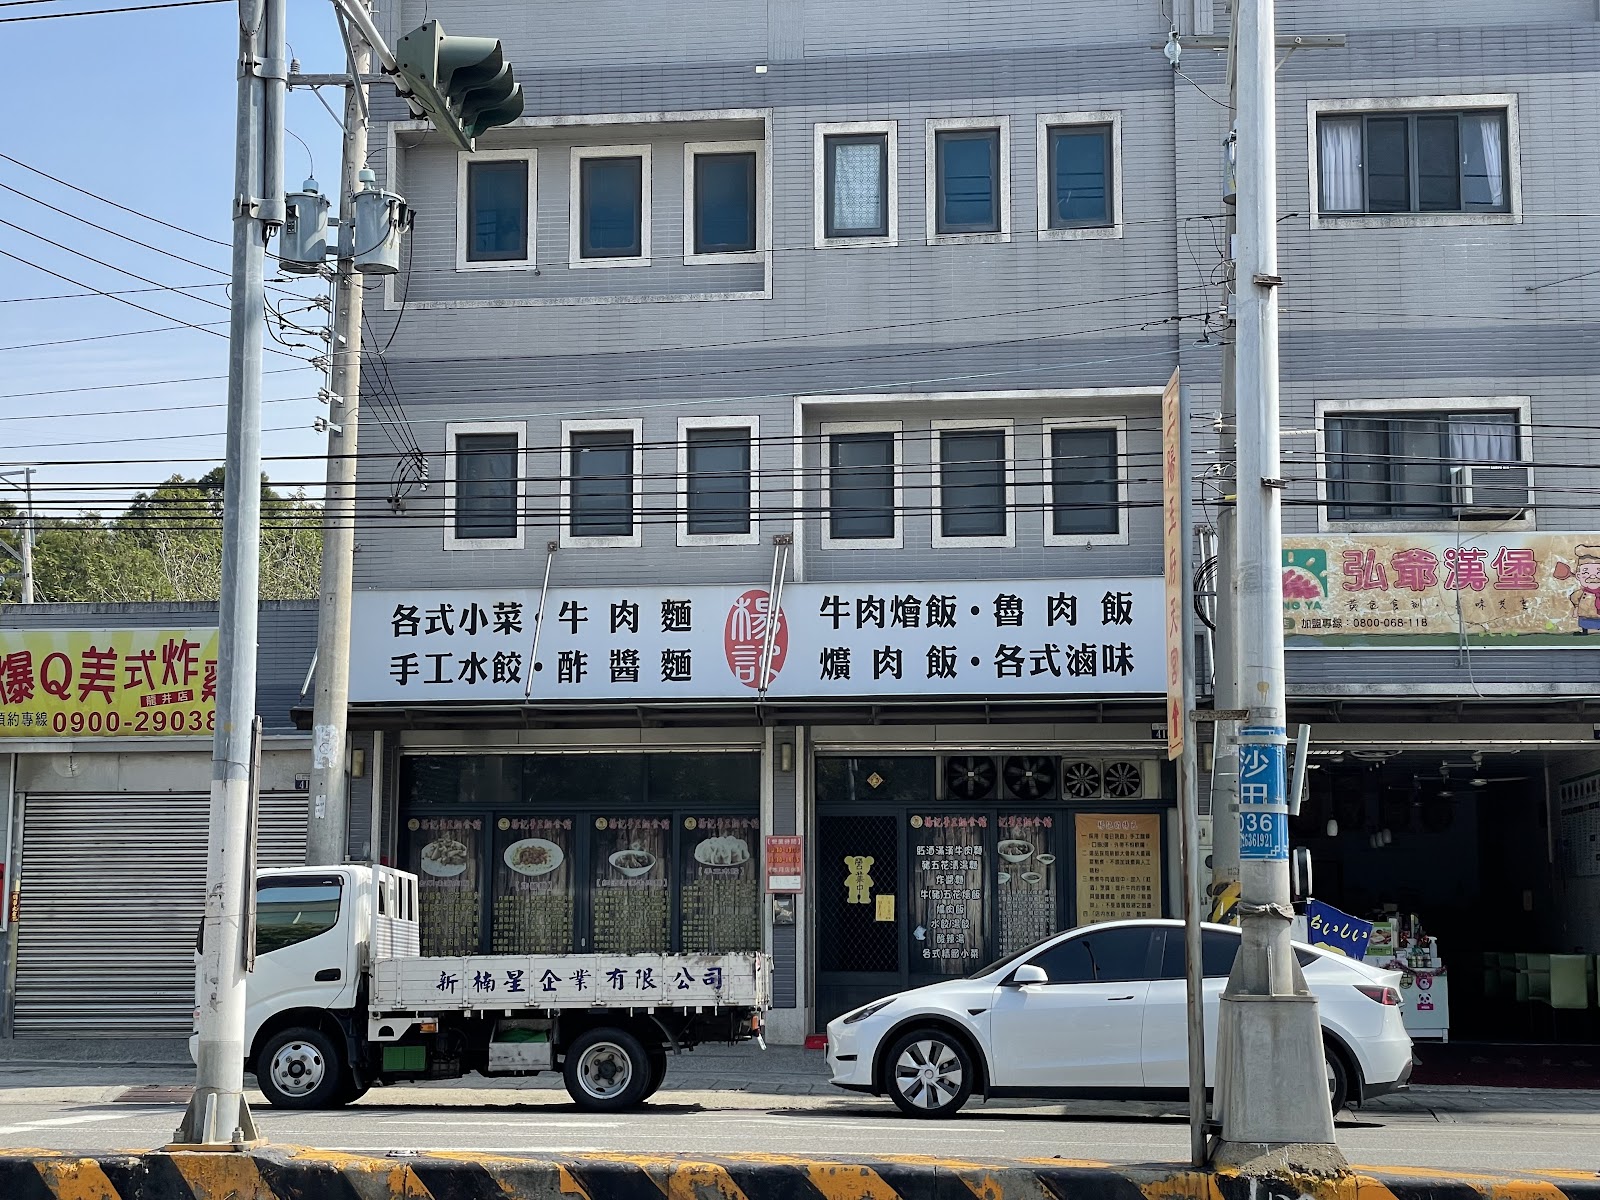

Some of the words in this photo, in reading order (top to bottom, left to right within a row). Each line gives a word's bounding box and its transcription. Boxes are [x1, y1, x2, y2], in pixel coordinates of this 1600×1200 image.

[1342, 546, 1540, 592] 弘爺漢堡
[391, 601, 524, 638] 各式小菜
[558, 598, 693, 635] 牛肉麵
[819, 594, 957, 630] 牛肉燴飯
[993, 591, 1134, 627] 魯肉飯
[389, 651, 523, 686] 手工水餃
[557, 648, 693, 684] 酢醬麵
[994, 642, 1135, 679] 各式滷味
[145, 690, 189, 706] 龍井店
[1240, 749, 1270, 805] 沙田
[1310, 913, 1368, 942] おいしい
[435, 966, 724, 995] 新楠星企業有限公司
